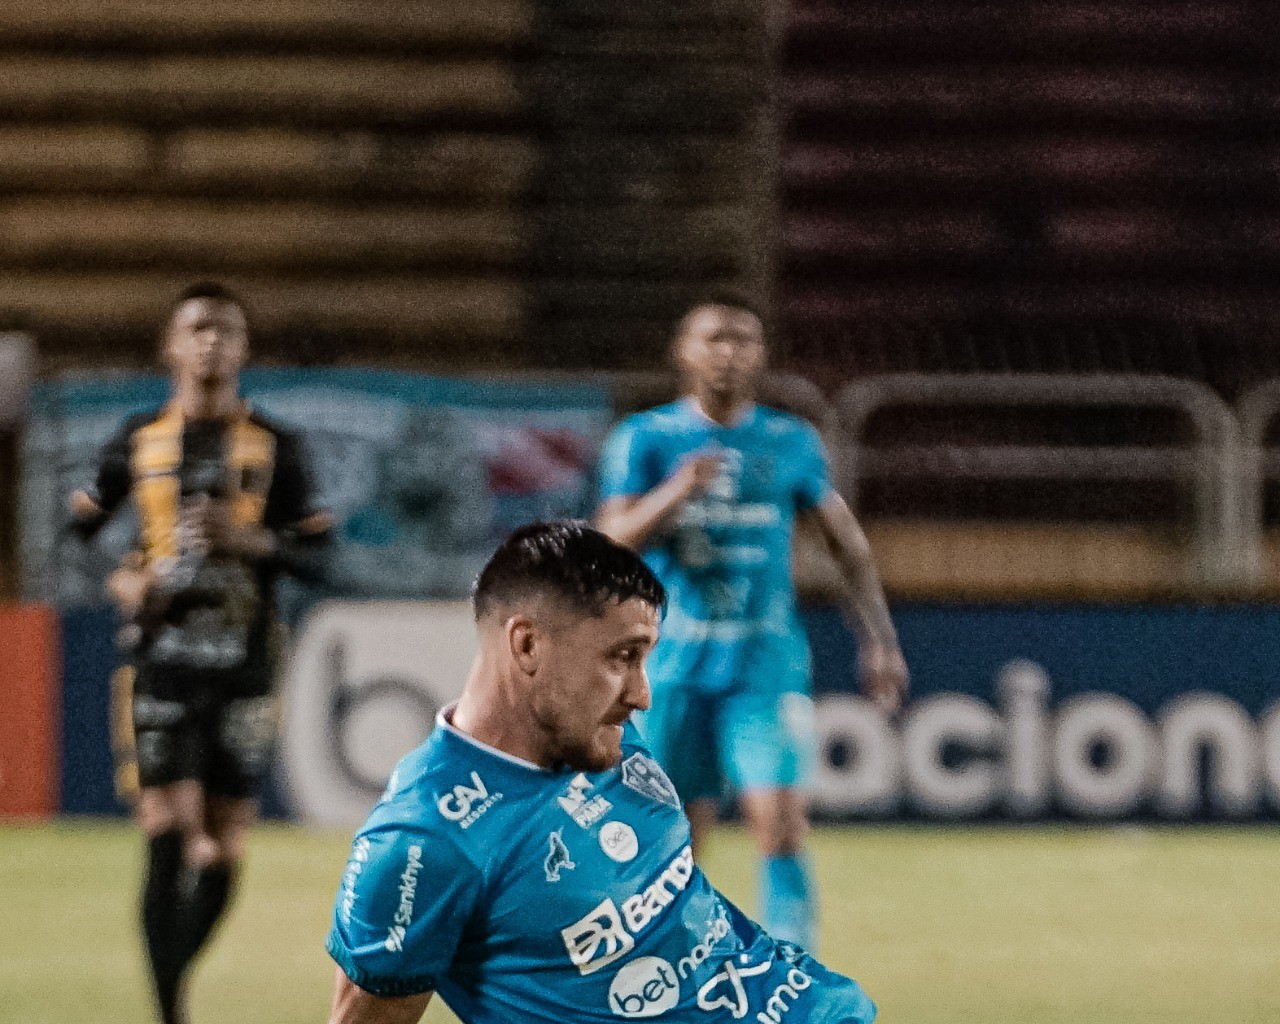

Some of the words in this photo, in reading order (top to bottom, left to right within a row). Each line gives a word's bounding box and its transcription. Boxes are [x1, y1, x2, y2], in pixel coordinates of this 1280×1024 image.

[437, 771, 489, 821] GAV
[394, 845, 423, 926] Sankhya
[612, 965, 678, 1013] bet
